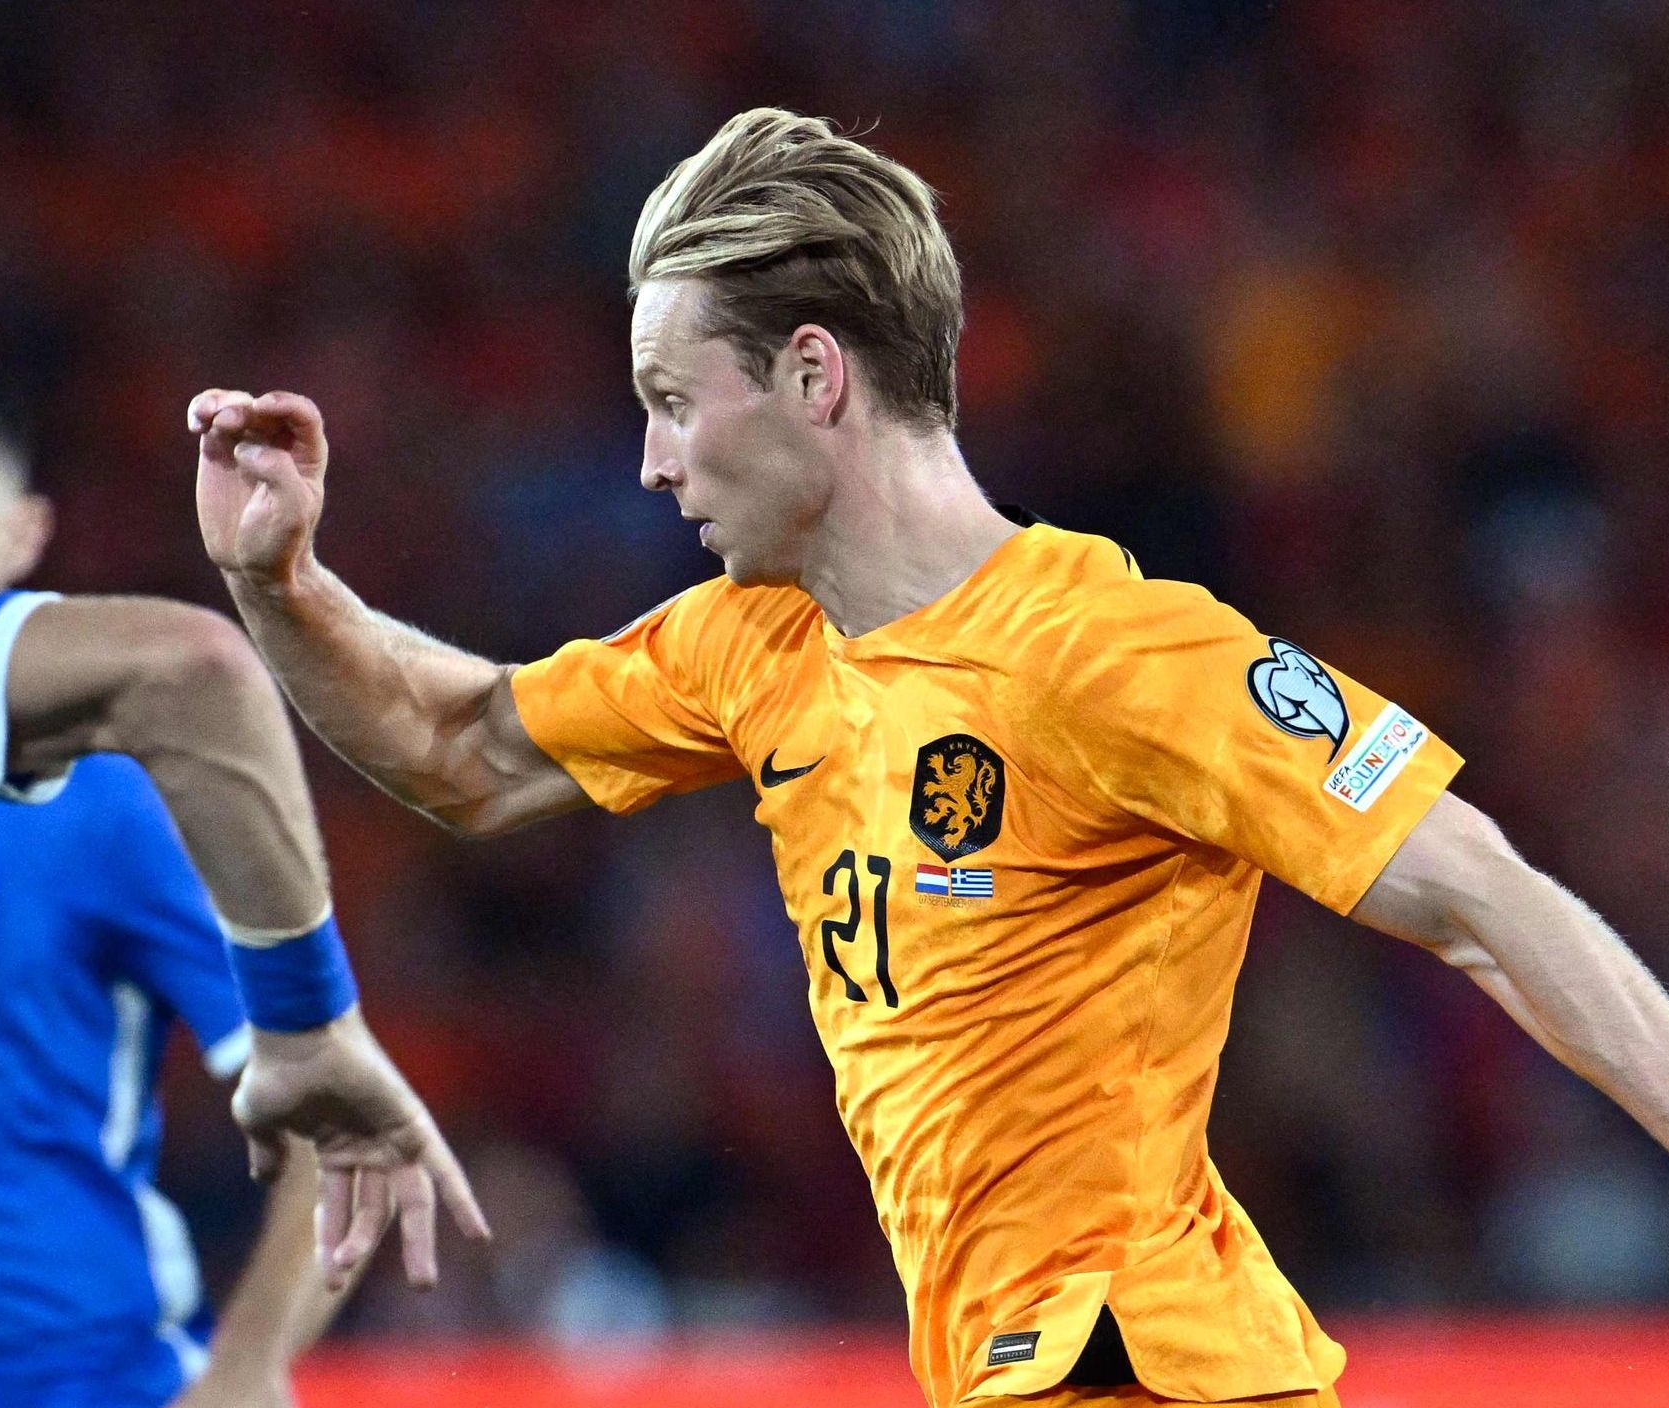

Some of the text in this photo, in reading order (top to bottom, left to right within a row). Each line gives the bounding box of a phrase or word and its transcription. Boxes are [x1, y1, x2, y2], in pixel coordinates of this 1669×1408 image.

[1328, 766, 1352, 790] UEFA
[1338, 717, 1414, 800] FOUNDATION
[821, 848, 899, 1009] 21
